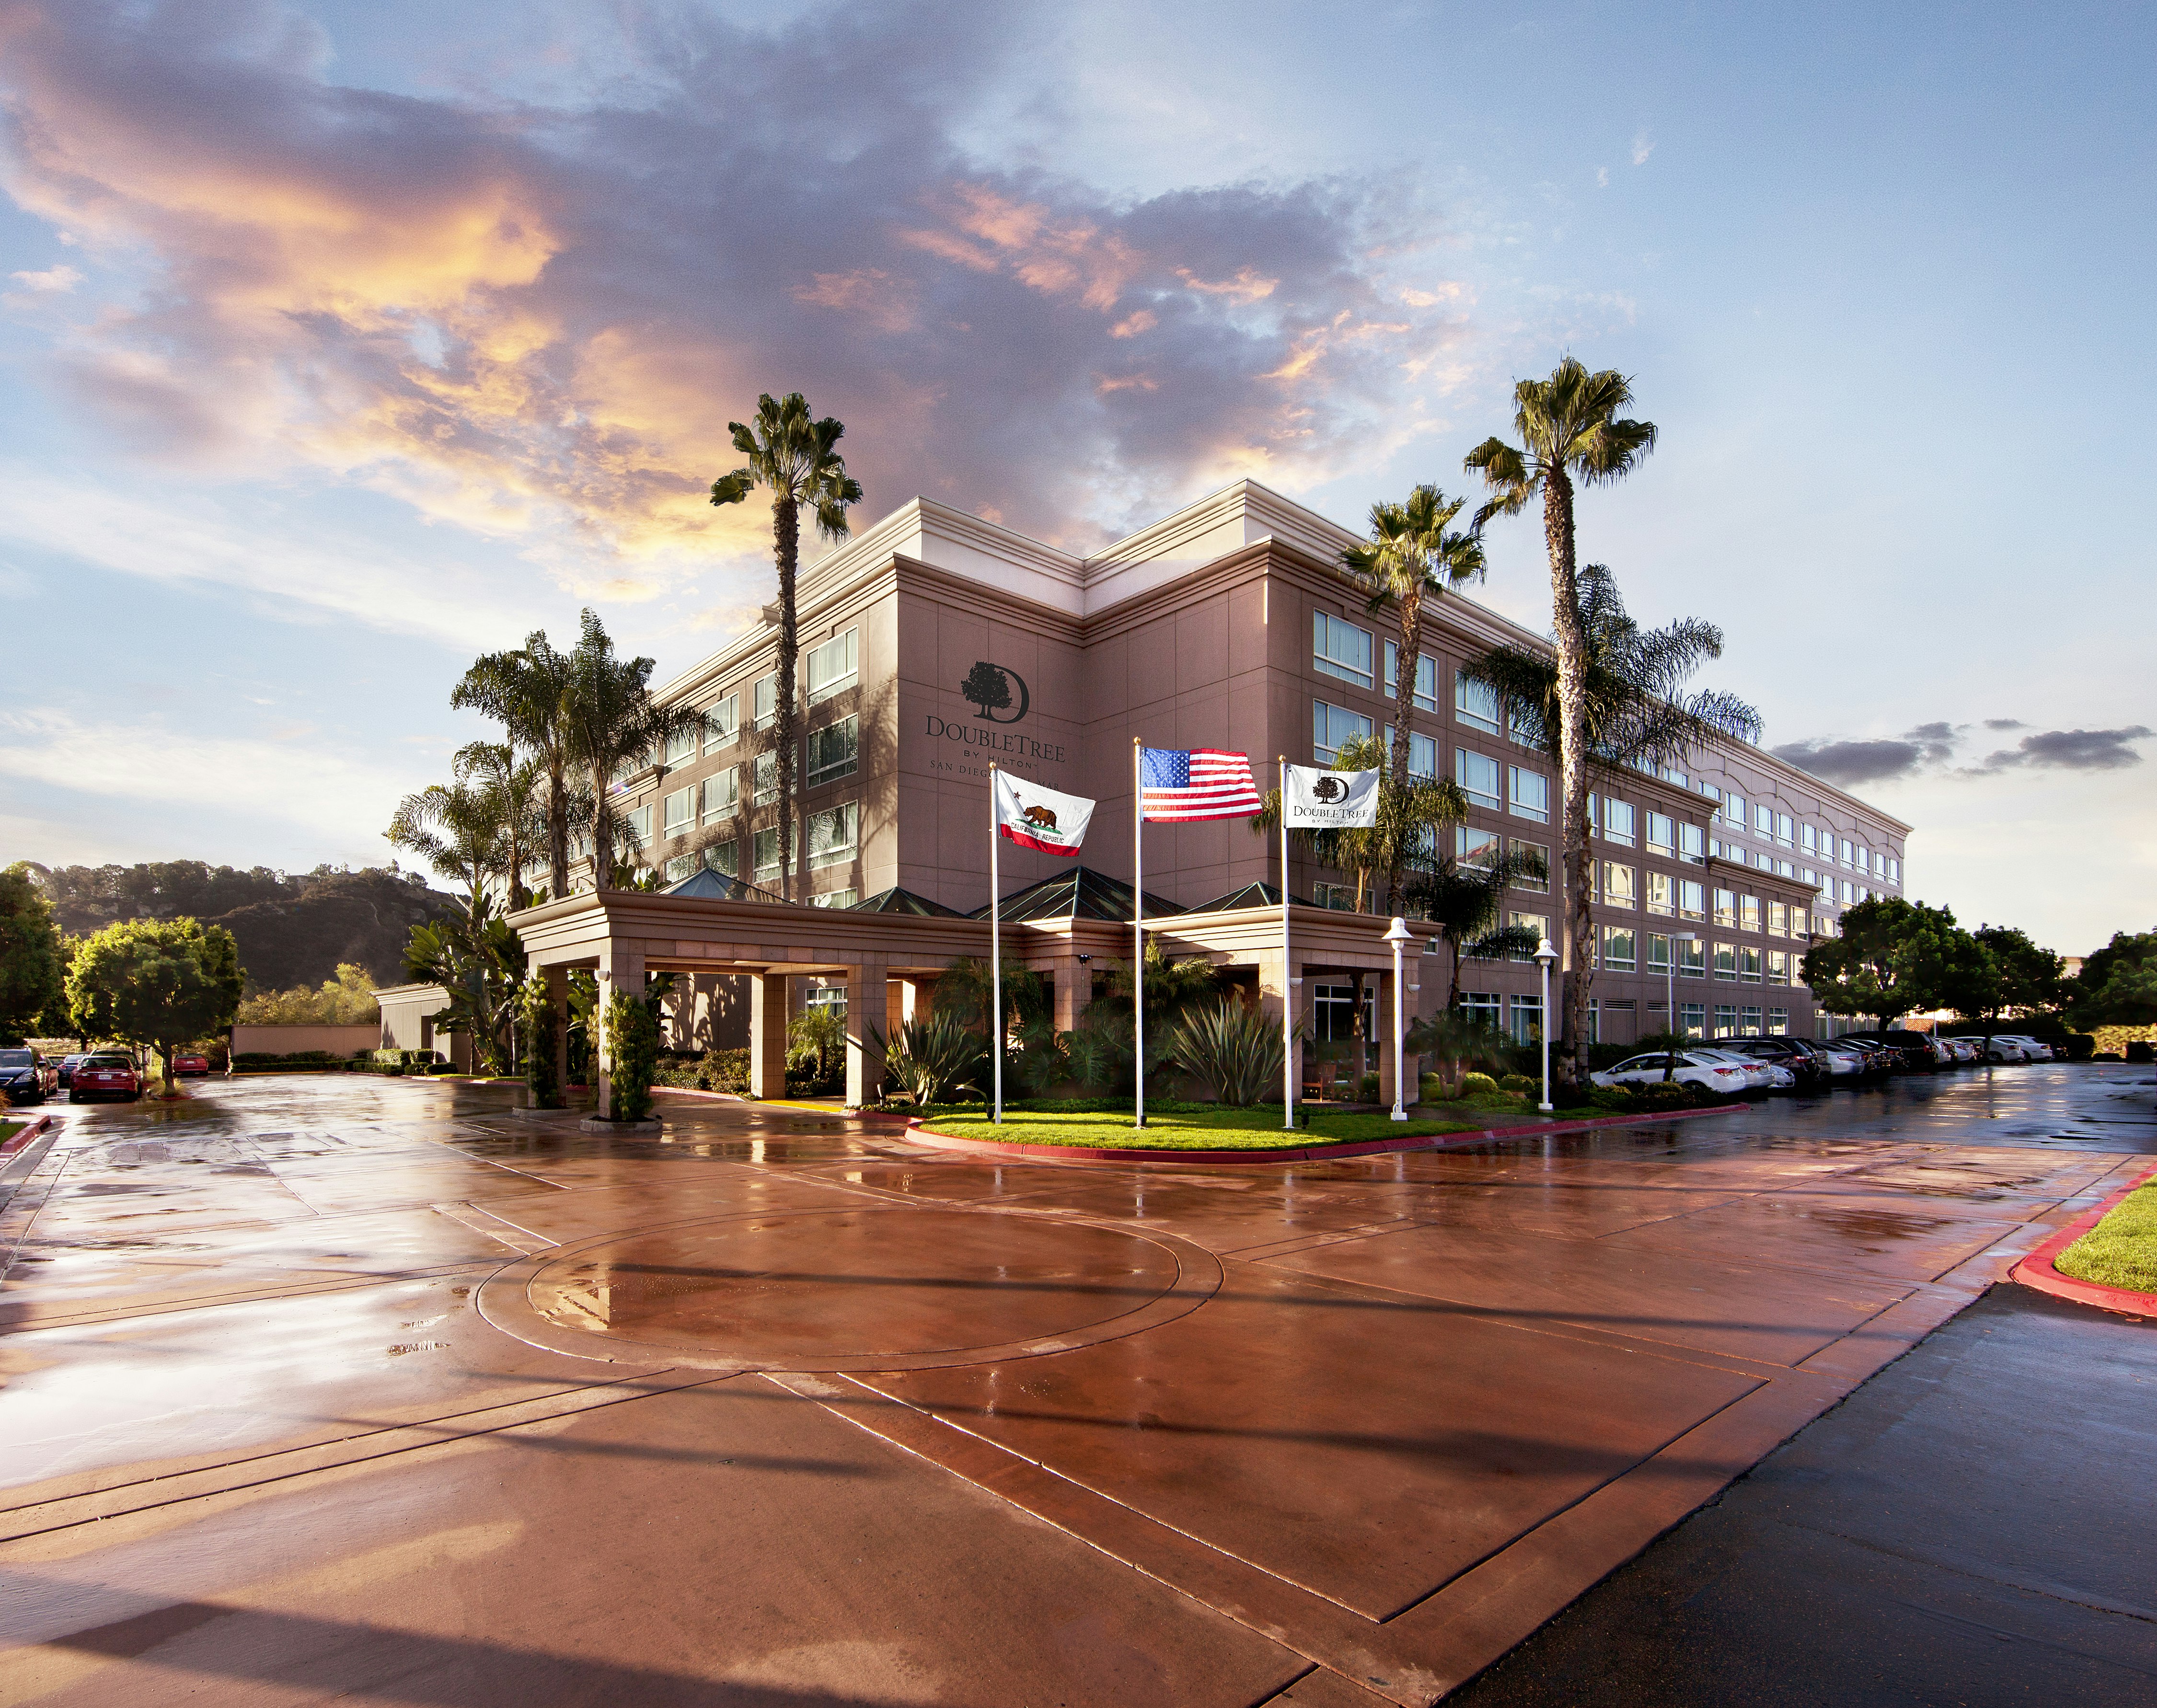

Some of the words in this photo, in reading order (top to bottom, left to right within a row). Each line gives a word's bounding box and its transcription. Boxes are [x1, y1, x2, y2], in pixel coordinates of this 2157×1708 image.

[925, 715, 1065, 762] DOUBLETREE
[964, 750, 979, 758] BY
[930, 760, 953, 771] SAN
[1293, 806, 1369, 819] DOUBLETREE
[1011, 822, 1039, 838] CALIFORNIA
[1042, 834, 1064, 844] REPUBLIC
